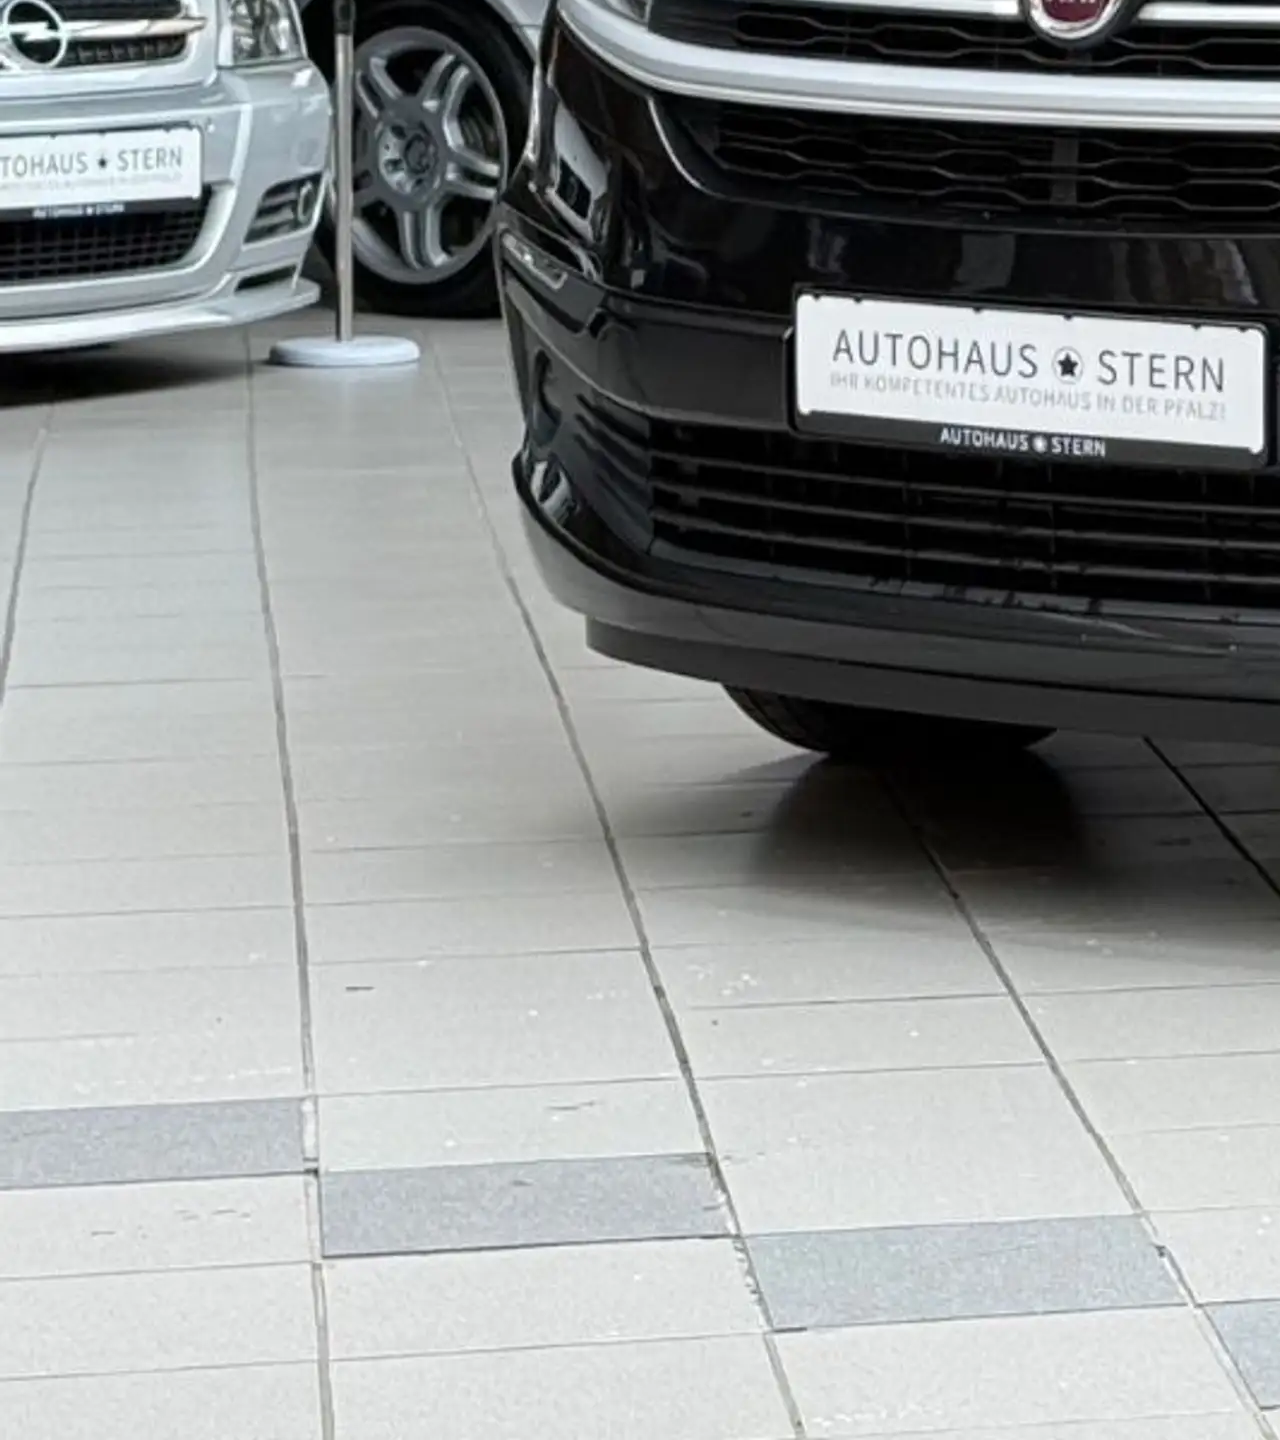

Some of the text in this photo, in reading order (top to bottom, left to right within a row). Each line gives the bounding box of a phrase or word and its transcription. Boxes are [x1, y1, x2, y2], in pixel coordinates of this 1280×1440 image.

[117, 147, 182, 172] STERN
[833, 328, 1225, 393] AUTOHAUS STERN
[864, 373, 990, 403] KOMPETENTES
[994, 384, 1092, 411] AUTOHAUS
[1096, 393, 1116, 413] IN
[1122, 395, 1160, 417] DER
[940, 427, 1106, 457] AUTOHAUS STERN
